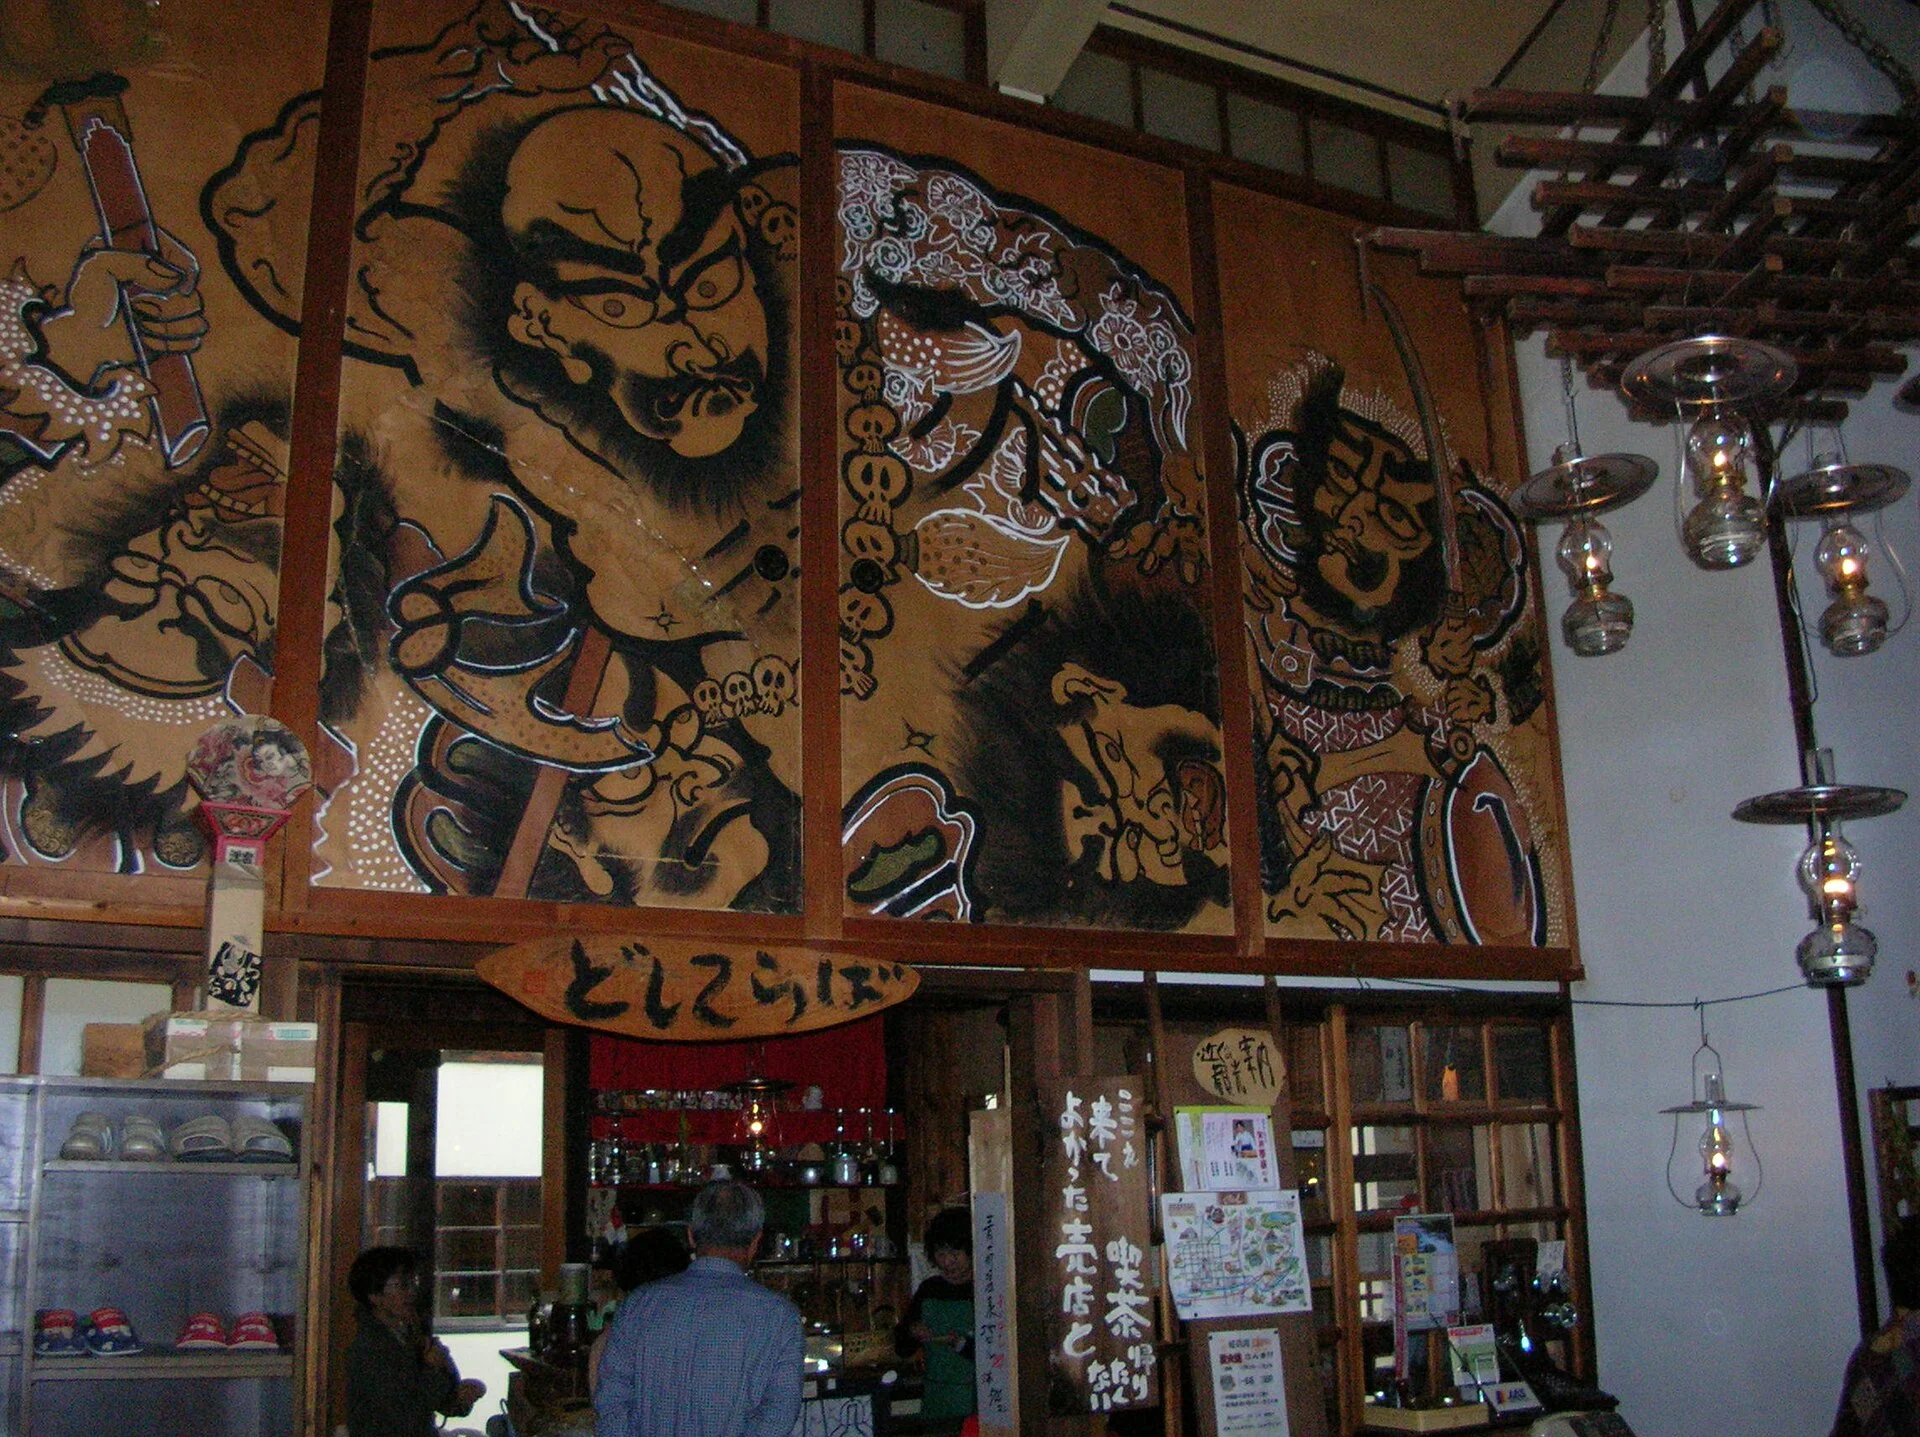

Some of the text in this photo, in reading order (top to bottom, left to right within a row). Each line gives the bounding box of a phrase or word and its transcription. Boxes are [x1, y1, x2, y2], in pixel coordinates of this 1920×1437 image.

[1089, 1094, 1119, 1181] 来て
[1056, 1218, 1098, 1359] 売店と
[1104, 1235, 1152, 1339] 喫茶
